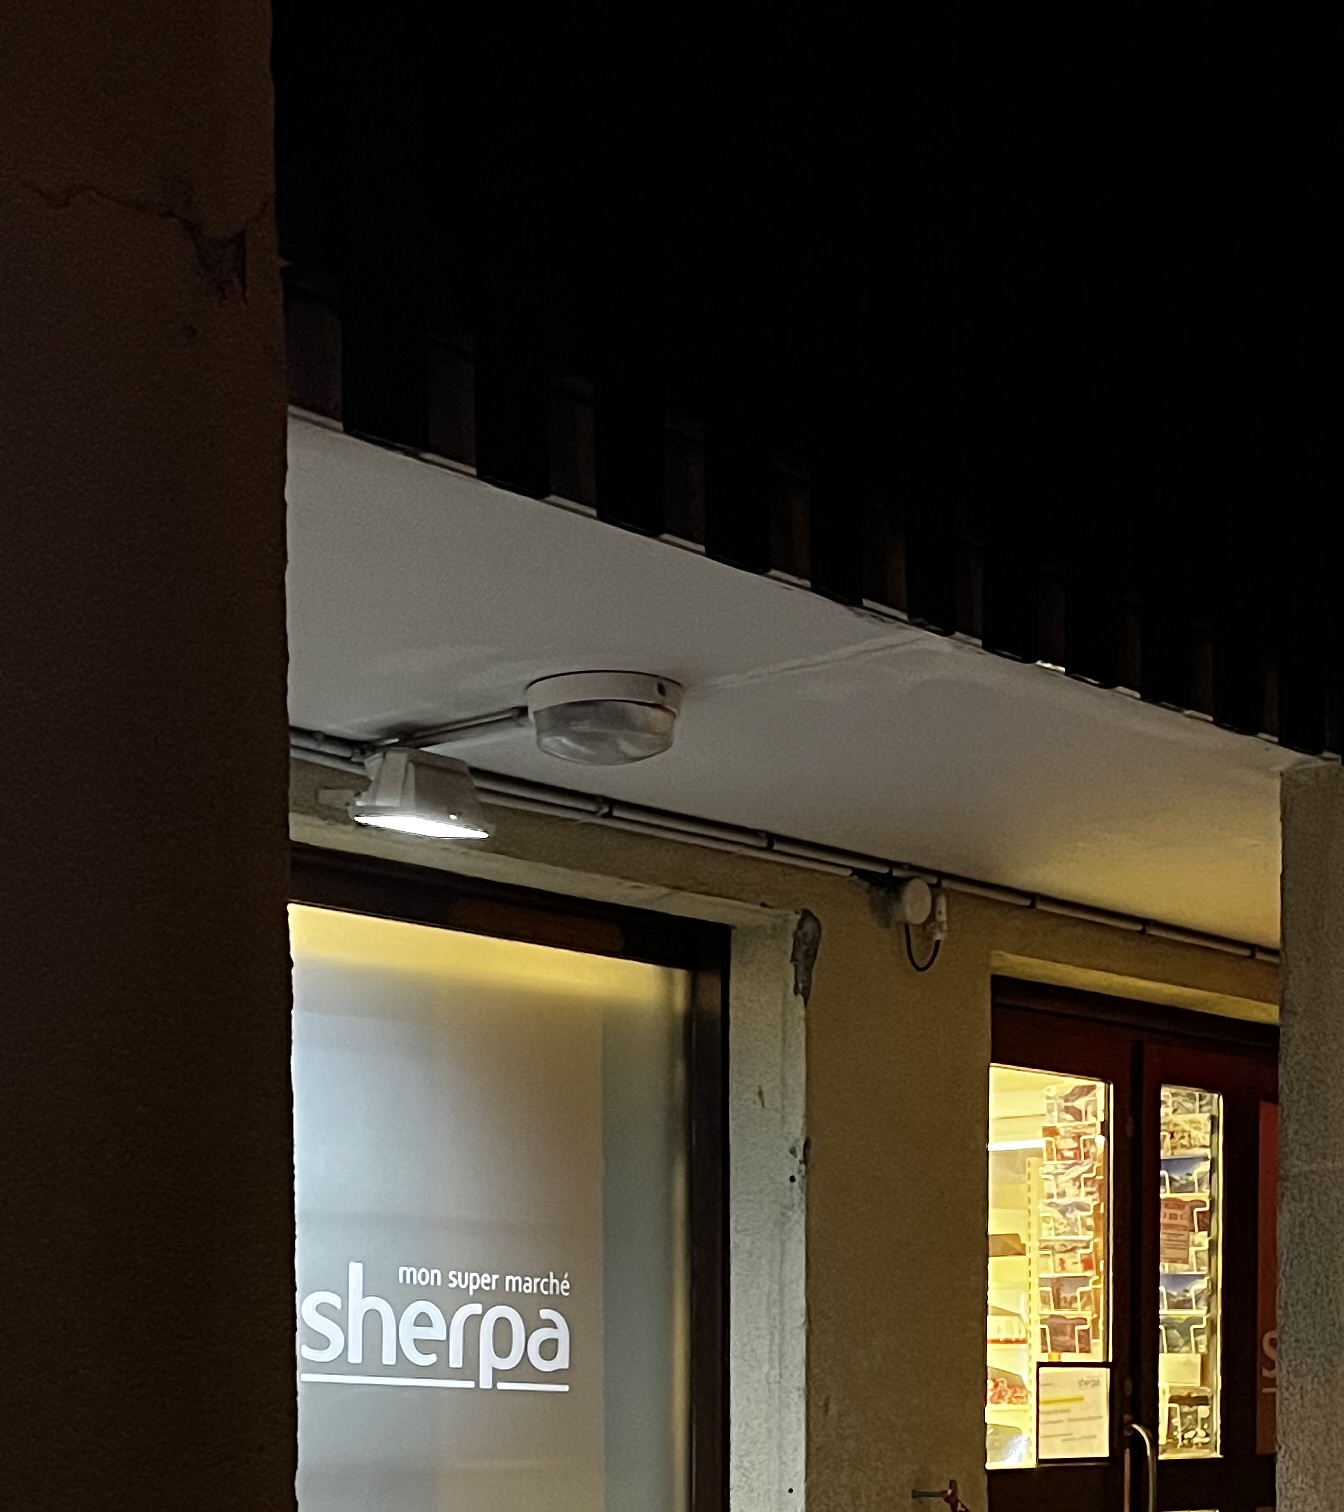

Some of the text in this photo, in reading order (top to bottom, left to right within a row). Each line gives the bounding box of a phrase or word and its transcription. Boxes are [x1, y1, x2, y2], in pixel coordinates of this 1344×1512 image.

[398, 1265, 571, 1296] mon super marché
[301, 1261, 570, 1389] sherpa
